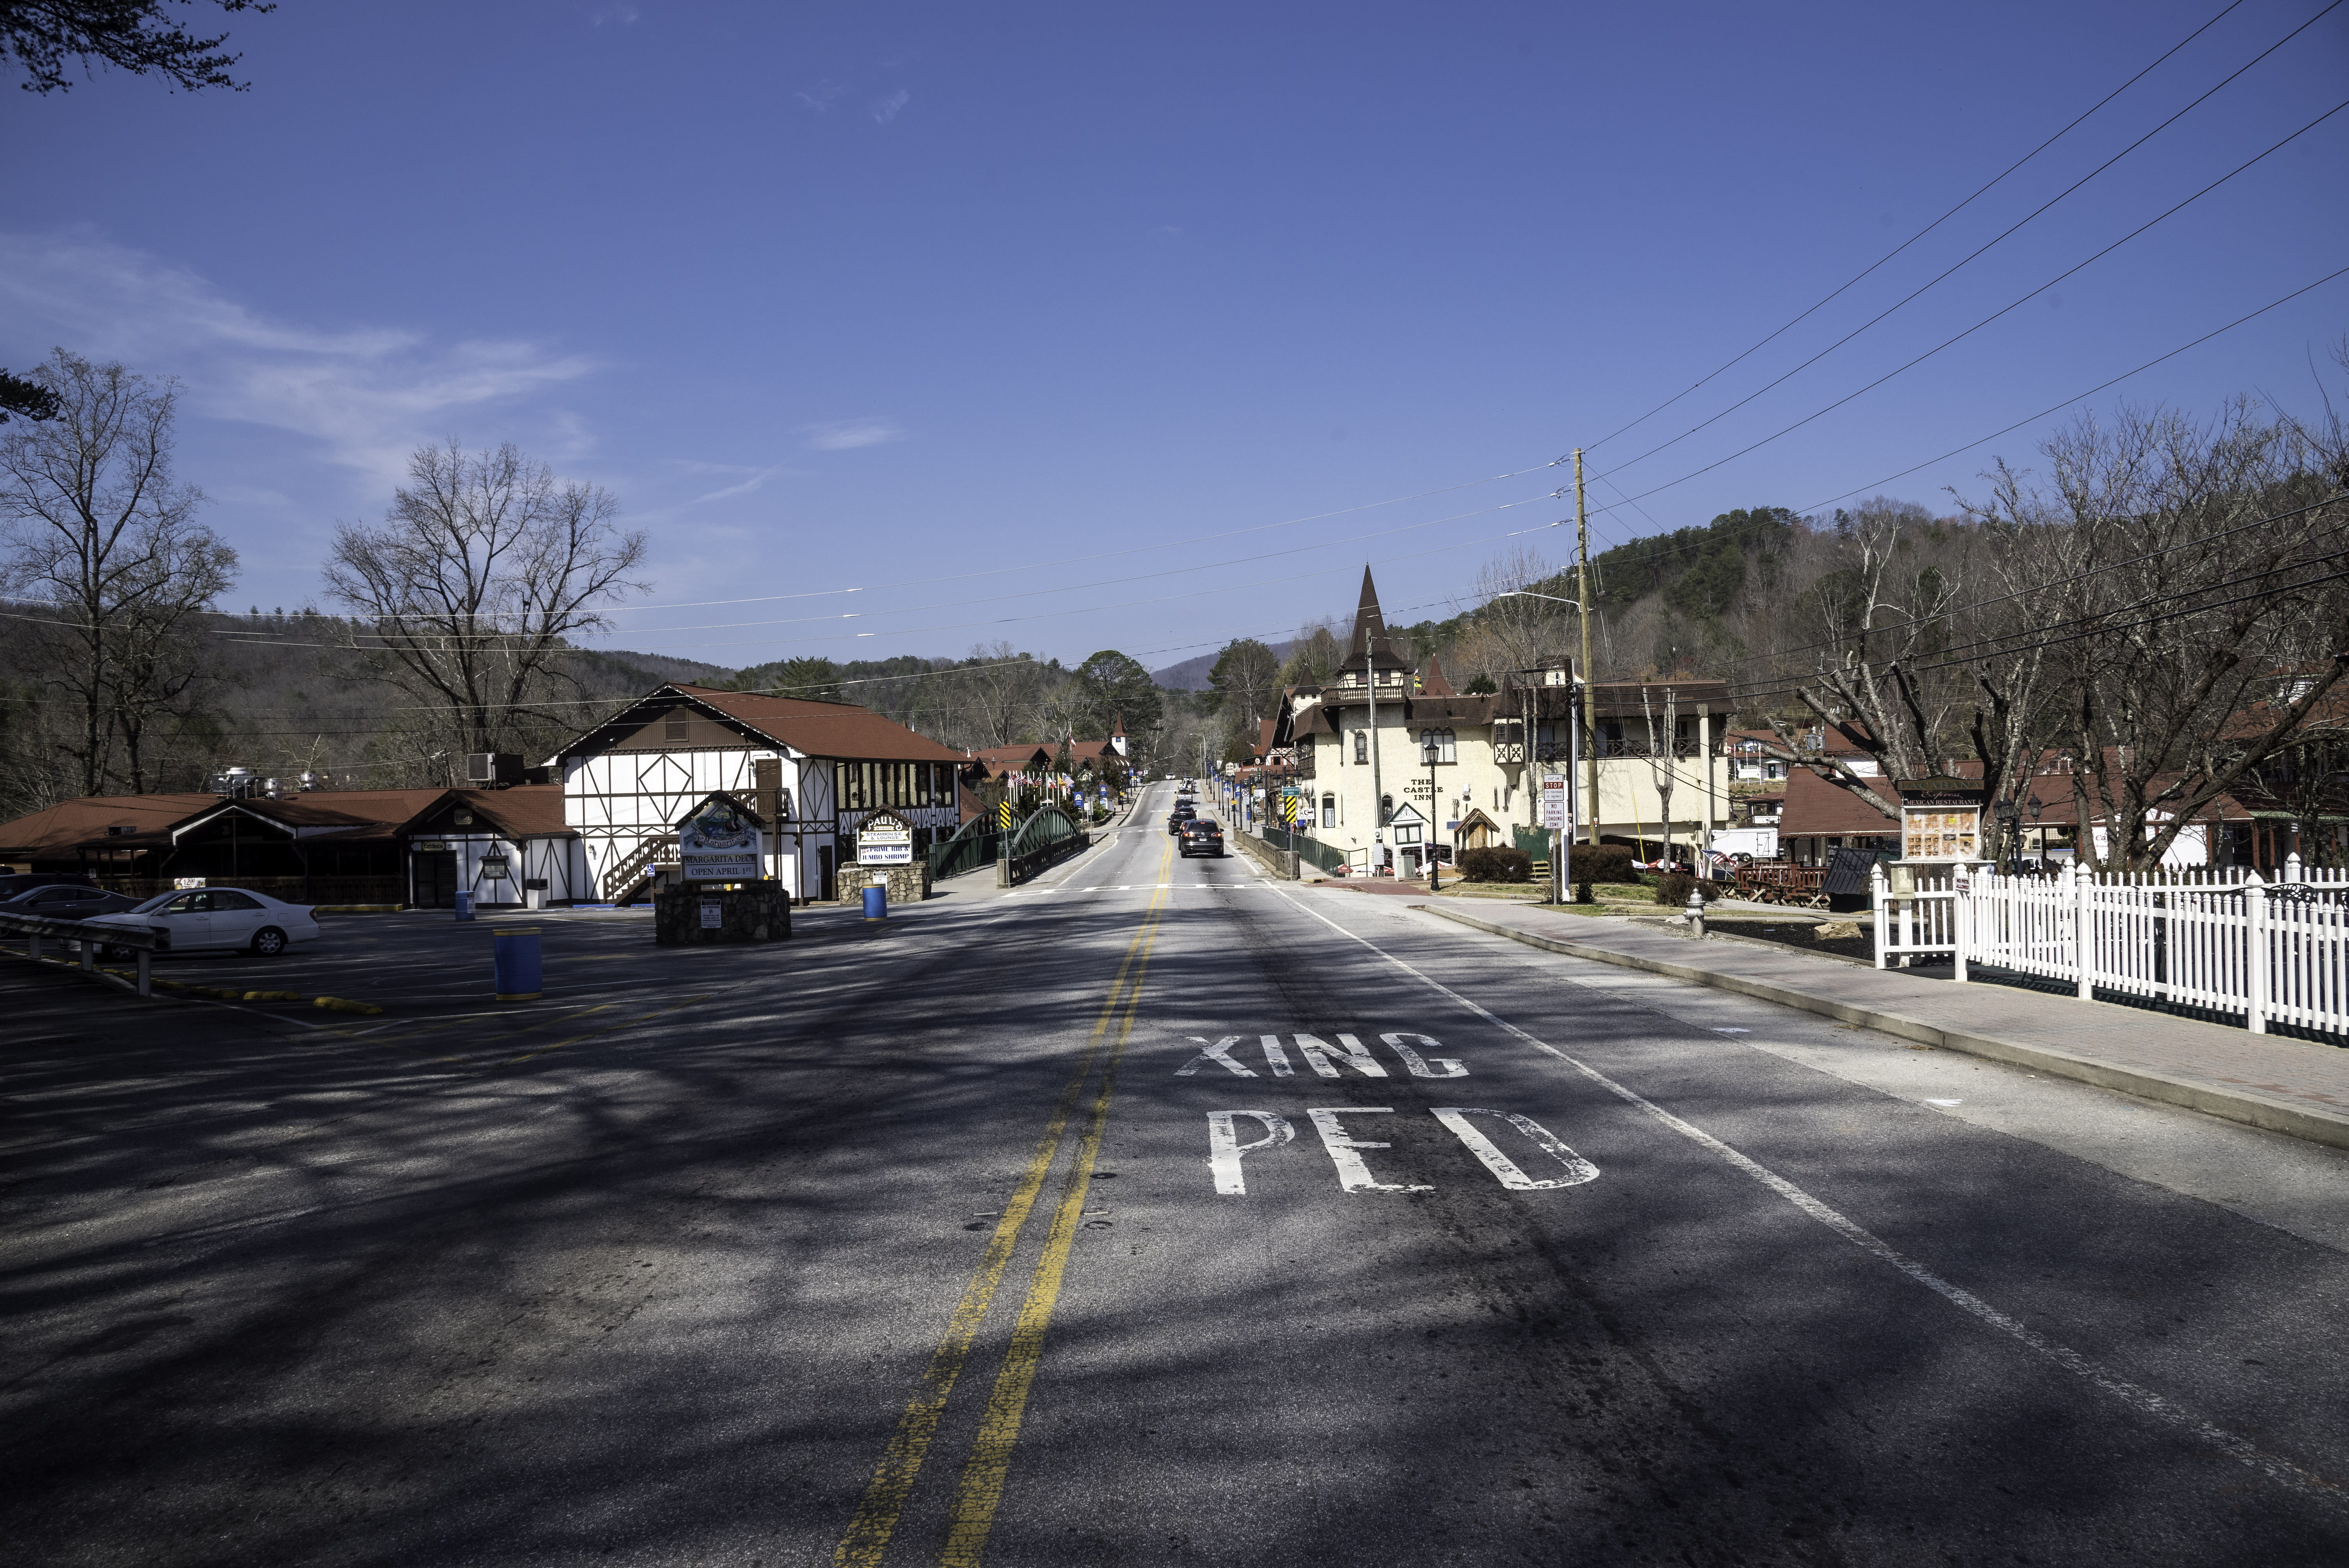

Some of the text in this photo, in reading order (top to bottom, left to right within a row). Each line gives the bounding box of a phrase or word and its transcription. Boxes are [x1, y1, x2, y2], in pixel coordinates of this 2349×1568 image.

[1920, 791, 1963, 799] Express
[867, 816, 903, 831] PAUL'S
[704, 835, 744, 848] Margaritas
[686, 855, 733, 864] MARGARITA
[1173, 1032, 1470, 1079] XING
[1205, 1107, 1600, 1196] PED
